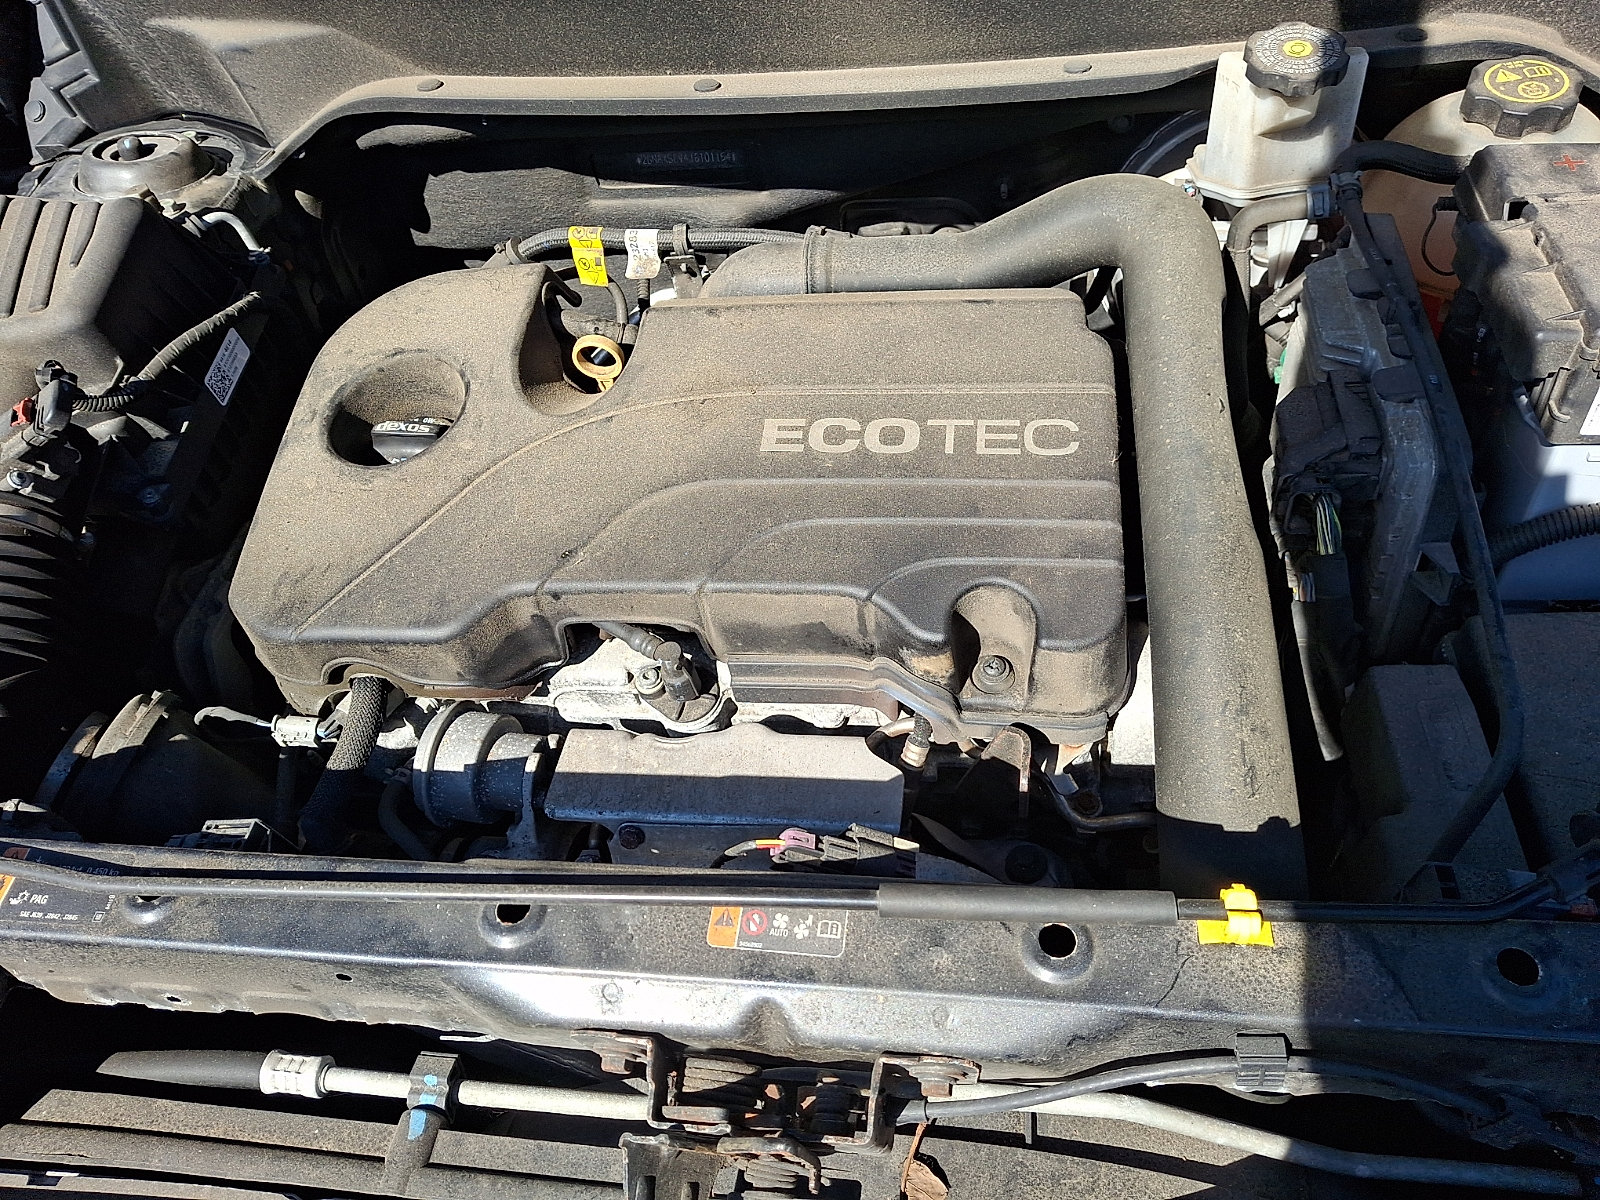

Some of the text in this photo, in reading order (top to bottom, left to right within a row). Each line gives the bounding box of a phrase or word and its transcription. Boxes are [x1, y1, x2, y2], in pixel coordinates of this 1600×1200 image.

[376, 421, 430, 433] dexos
[759, 418, 1080, 455] ECOTEC
[29, 894, 49, 905] PAG
[769, 927, 789, 938] AUTO
